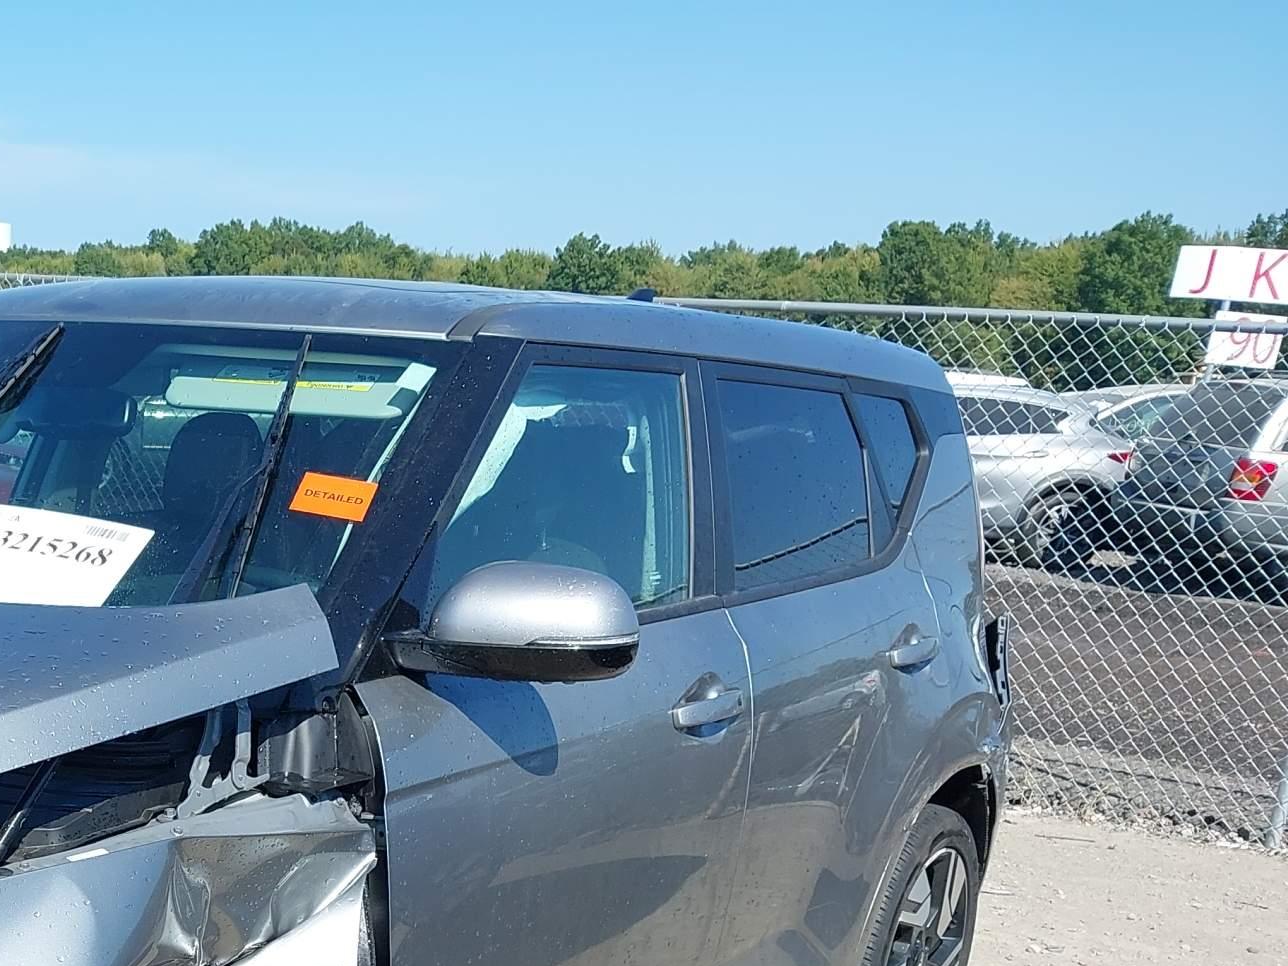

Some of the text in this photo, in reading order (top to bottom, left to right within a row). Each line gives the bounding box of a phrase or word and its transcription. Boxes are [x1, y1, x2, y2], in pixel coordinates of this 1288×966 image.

[1188, 248, 1288, 300] J K
[1226, 316, 1278, 364] 90
[303, 488, 364, 505] DETAILED
